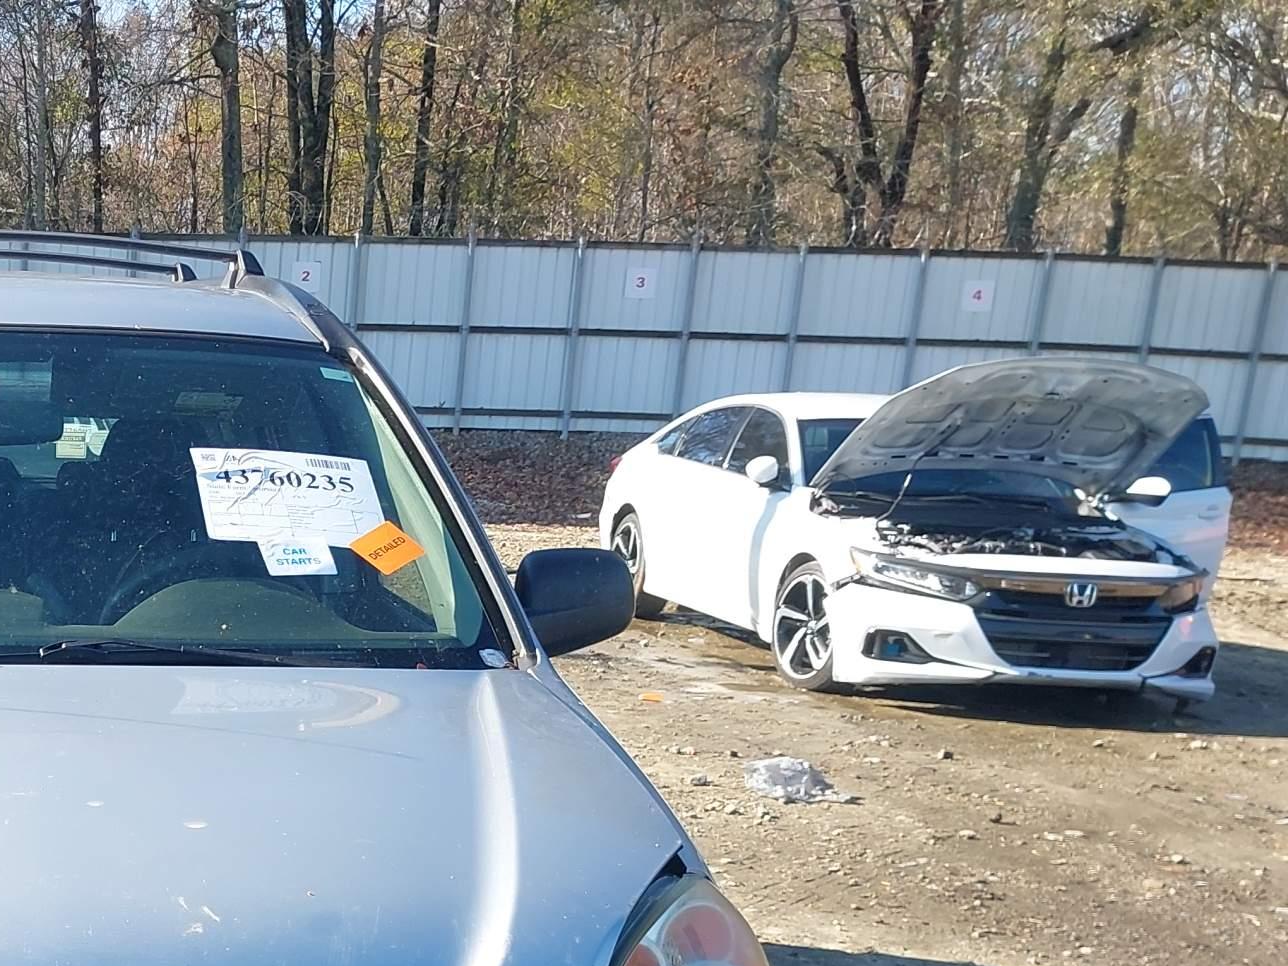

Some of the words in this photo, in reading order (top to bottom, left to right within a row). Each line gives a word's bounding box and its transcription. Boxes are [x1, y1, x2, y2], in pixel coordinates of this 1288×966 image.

[301, 270, 311, 282] 2
[636, 276, 646, 288] 3
[972, 289, 982, 301] 4
[215, 468, 354, 493] 43760235
[282, 548, 308, 556] CAR
[368, 536, 406, 560] DETAILED
[276, 557, 322, 566] STARTS
